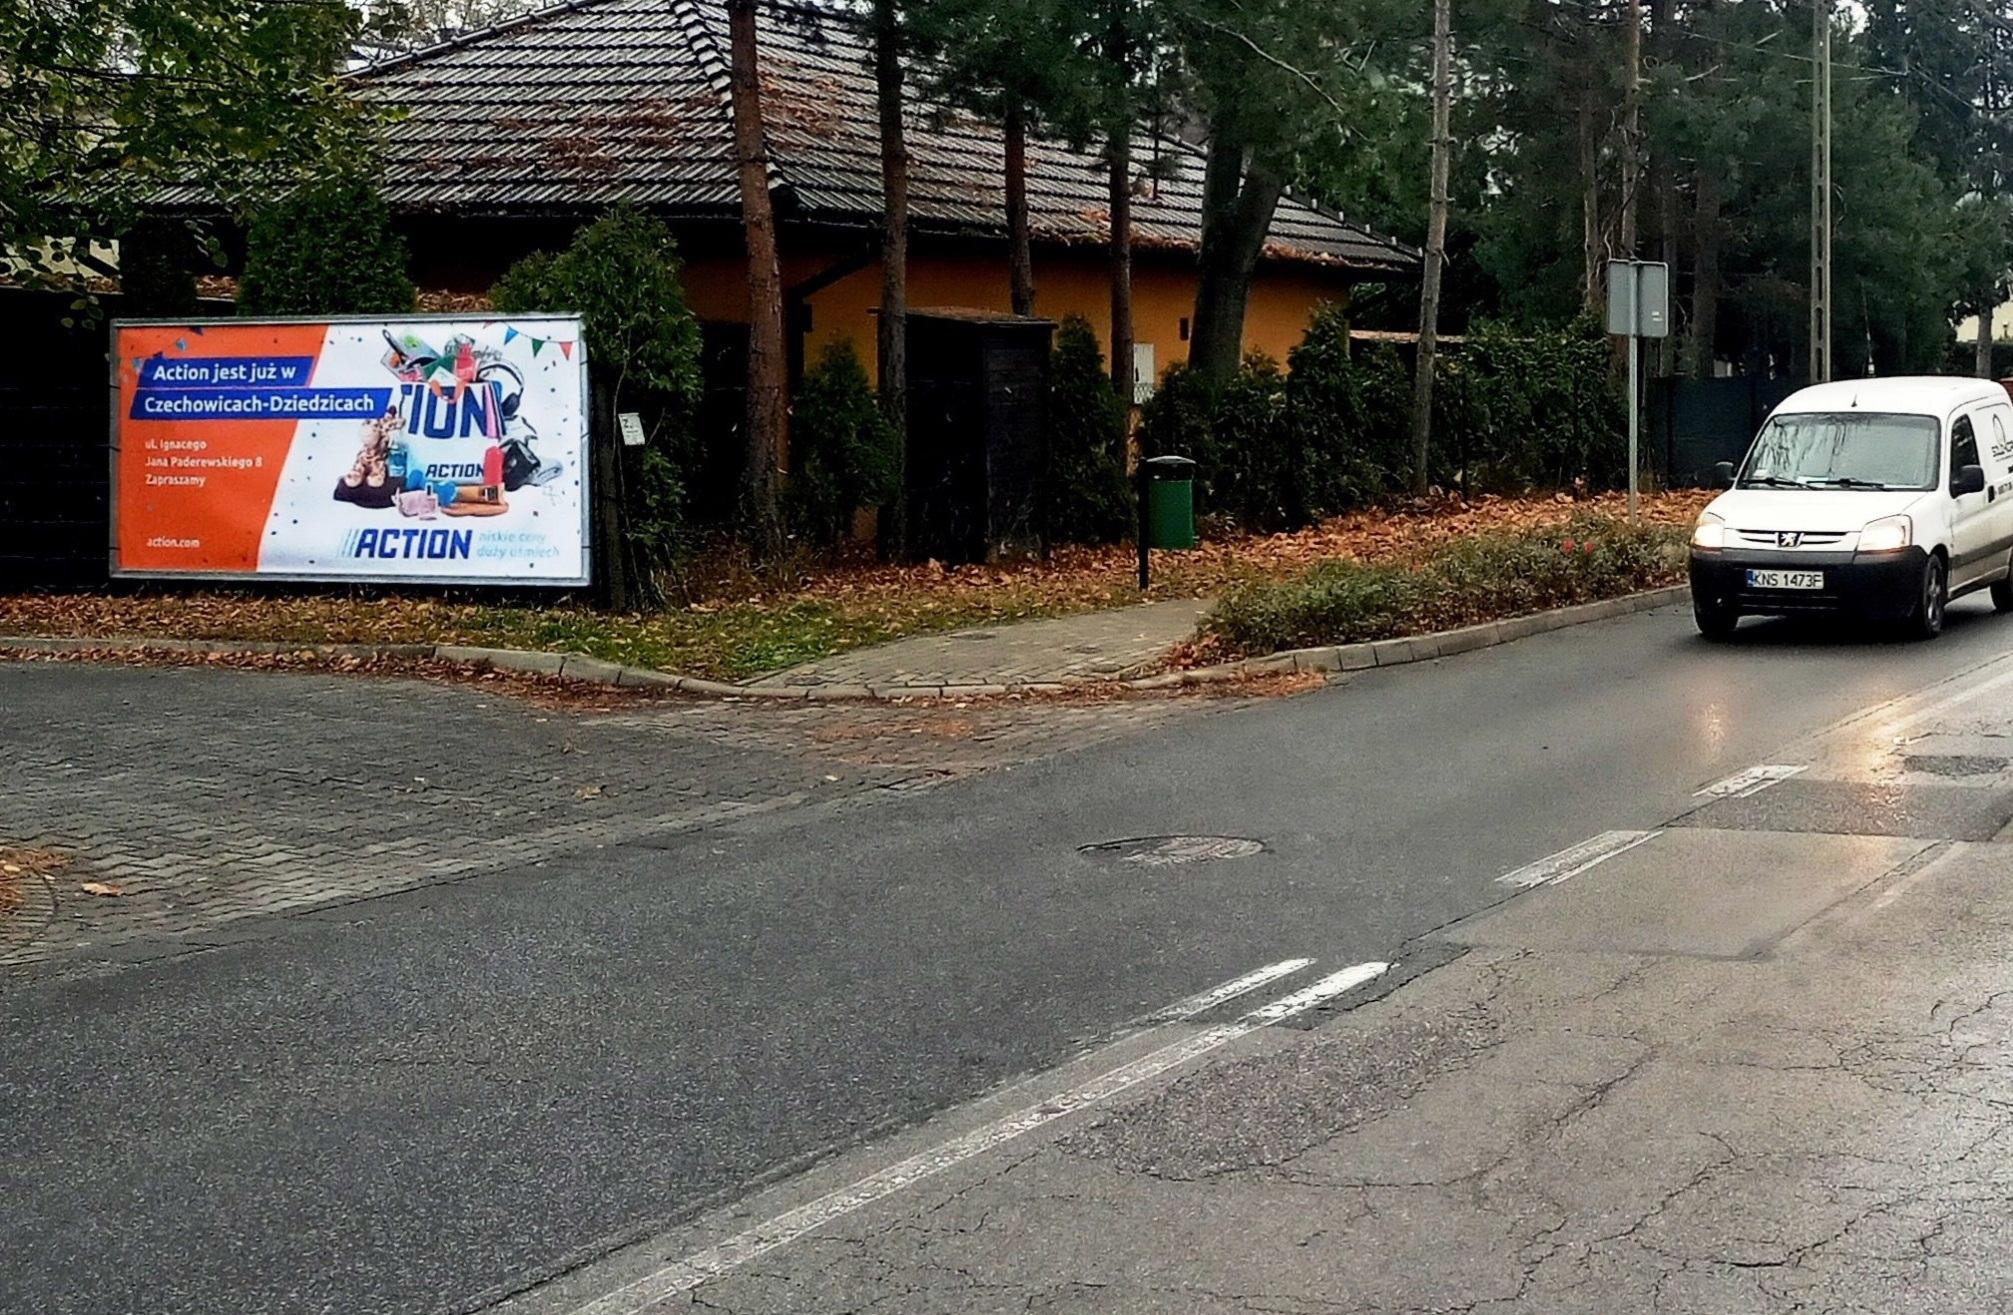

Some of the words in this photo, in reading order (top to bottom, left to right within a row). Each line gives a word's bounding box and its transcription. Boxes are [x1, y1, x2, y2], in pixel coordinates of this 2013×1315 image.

[153, 363, 209, 380] Action
[212, 363, 246, 383] jest
[248, 363, 276, 383] już
[281, 366, 296, 379] w
[144, 394, 374, 413] Czechowicach-Dziedzicach
[160, 439, 207, 451] Ignacego
[145, 457, 168, 467] Jana
[171, 456, 253, 469] Paderewskiego
[145, 474, 206, 487] Zapraszamy
[146, 536, 200, 548] action.com
[354, 528, 473, 559] ACTION
[1755, 573, 1779, 586] KNS
[1783, 574, 1822, 587] 1473F
